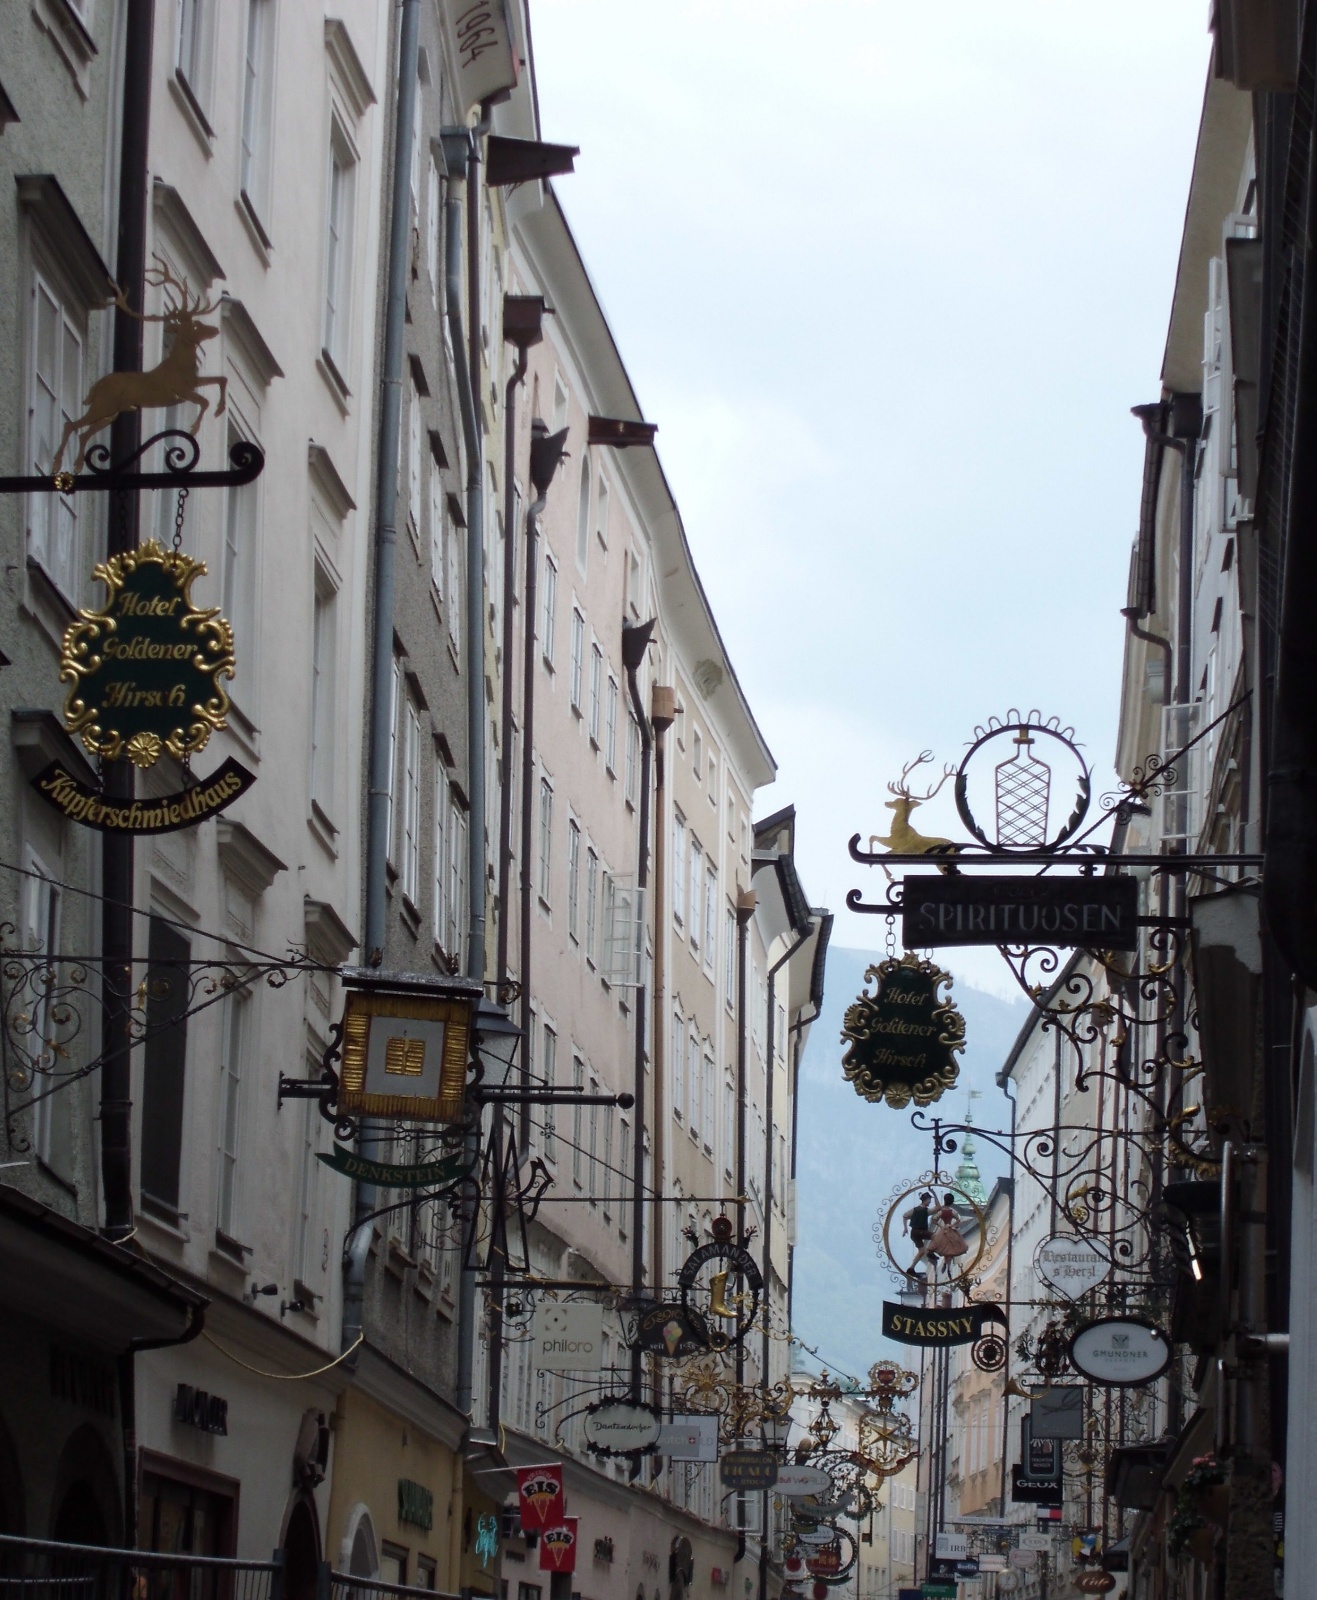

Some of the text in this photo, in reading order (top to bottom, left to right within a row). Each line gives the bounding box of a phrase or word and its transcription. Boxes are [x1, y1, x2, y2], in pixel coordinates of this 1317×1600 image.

[456, 1, 498, 69] 1964
[116, 592, 181, 618] Hotel
[101, 636, 198, 661] Goldener
[101, 681, 187, 709] Hirsch
[40, 769, 242, 830] Kupferschmiedhaus
[919, 901, 1121, 932] SPIRITUOSEN
[883, 988, 929, 1007] Hotel
[870, 1015, 937, 1038] Goldener
[872, 1048, 927, 1069] Hirsch
[344, 1158, 446, 1183] DENKSTEIN
[684, 1244, 757, 1277] SALAMANDER
[890, 1314, 974, 1337] STASSNY
[542, 1339, 593, 1359] philoro
[649, 1342, 665, 1350] seit
[1092, 1349, 1148, 1358] GMUNDNER
[592, 1421, 652, 1433] Dantendorfer
[523, 1481, 558, 1497] EIS
[545, 1531, 572, 1544] EIS
